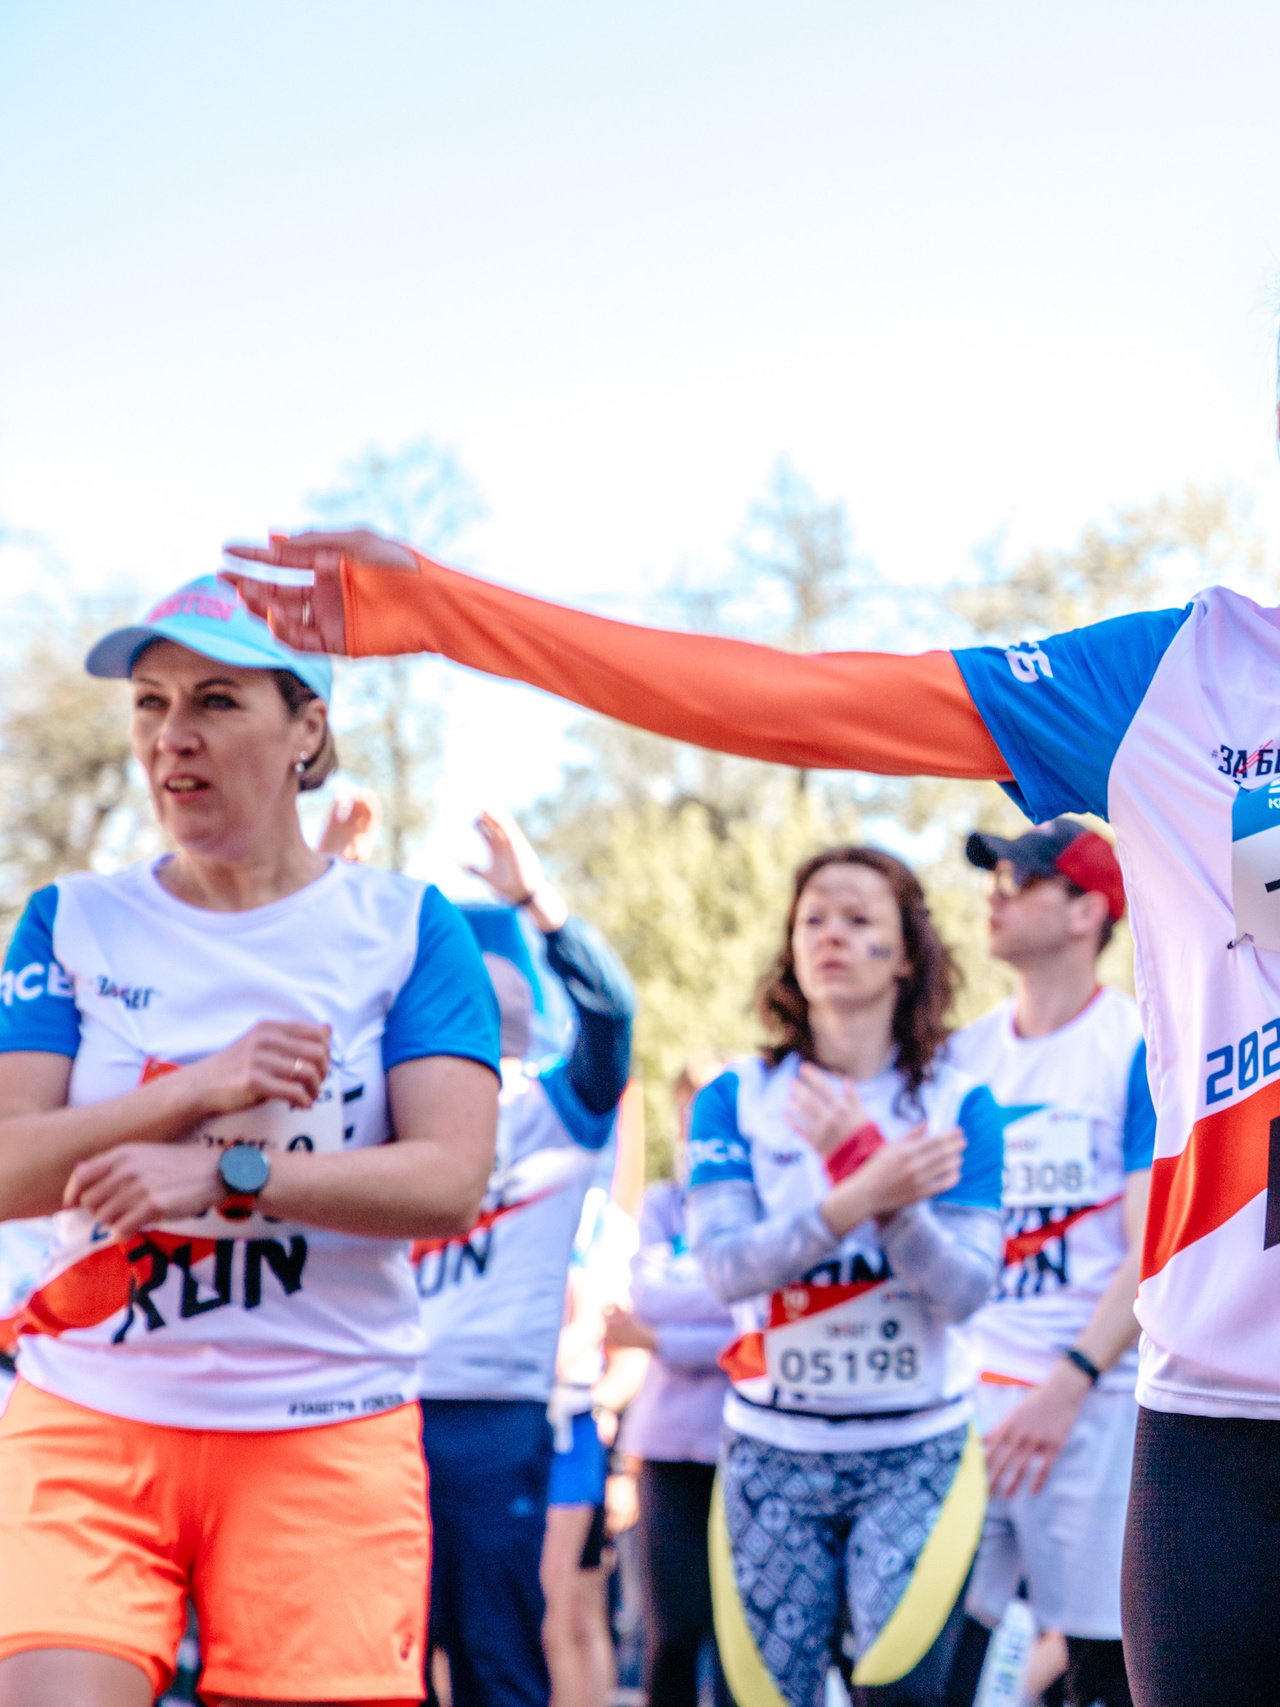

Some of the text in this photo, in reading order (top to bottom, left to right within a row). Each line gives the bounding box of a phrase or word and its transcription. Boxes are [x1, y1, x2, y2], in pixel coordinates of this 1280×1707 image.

[1001, 1162, 1085, 1195] 308
[112, 1235, 308, 1346] RUN
[414, 1228, 494, 1299] UN
[780, 1347, 920, 1386] 05198
